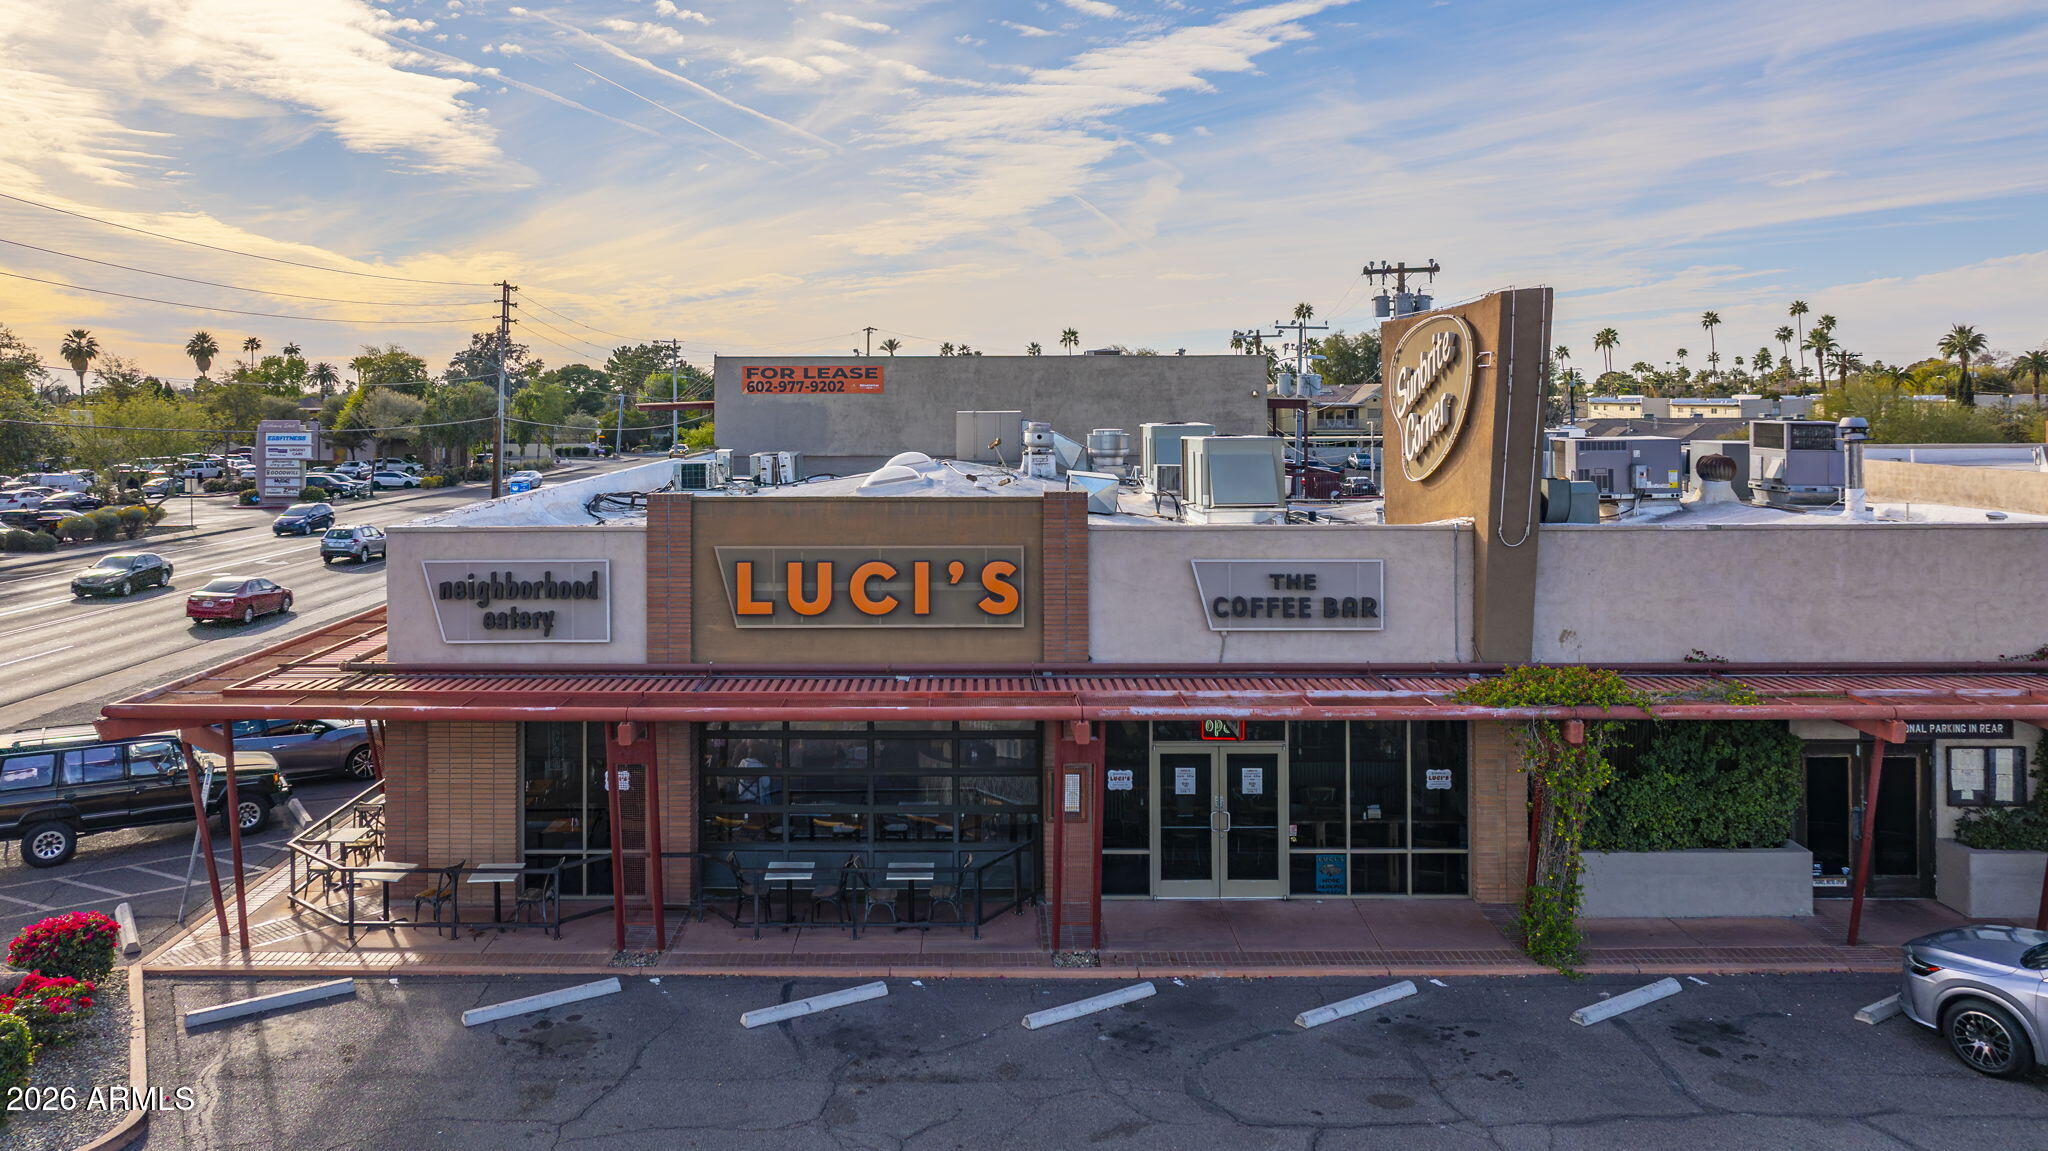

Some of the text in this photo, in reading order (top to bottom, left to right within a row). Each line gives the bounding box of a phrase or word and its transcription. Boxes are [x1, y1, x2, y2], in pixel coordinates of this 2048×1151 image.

[746, 367, 878, 379] FOR LEASE
[746, 380, 845, 392] 602-977-9202
[1397, 331, 1456, 418] Sunbrite
[1405, 392, 1453, 461] Corner
[439, 571, 598, 608] neighborhood
[735, 560, 1019, 616] LUCI'S
[1269, 573, 1317, 590] THE
[1213, 596, 1378, 618] COFFEE BAR
[483, 606, 555, 637] eatery
[1929, 724, 1966, 733] PARKING
[1969, 724, 1977, 733] IN
[1980, 724, 2004, 733] REAR
